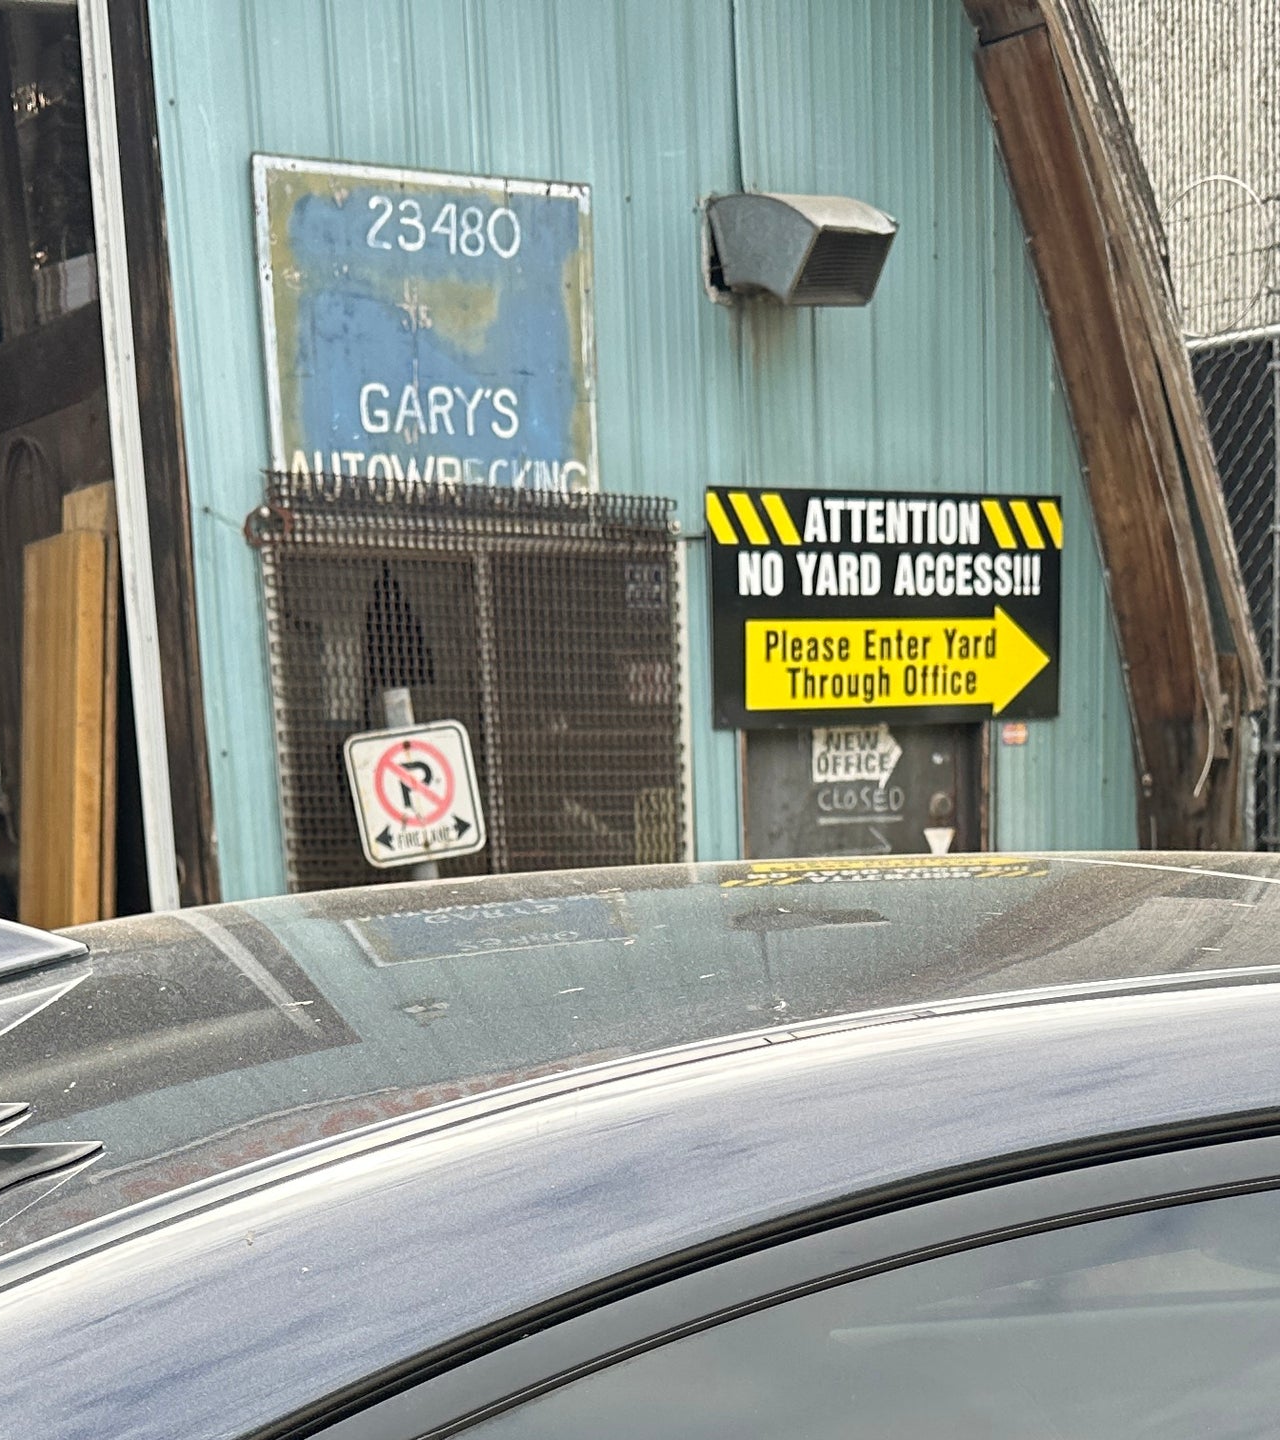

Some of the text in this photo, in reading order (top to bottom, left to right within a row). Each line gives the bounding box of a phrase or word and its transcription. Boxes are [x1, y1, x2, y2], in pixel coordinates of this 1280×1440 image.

[367, 195, 521, 258] 23480
[360, 383, 519, 438] GARY'S
[803, 498, 981, 545] ATTENTION
[738, 551, 1041, 597] NO YARD ACCESS!!!
[765, 627, 997, 663] Please Enter Yard
[787, 664, 977, 703] Through Office
[825, 731, 880, 752] NEW
[816, 752, 893, 776] OFFICE
[817, 785, 905, 813] CLOSED
